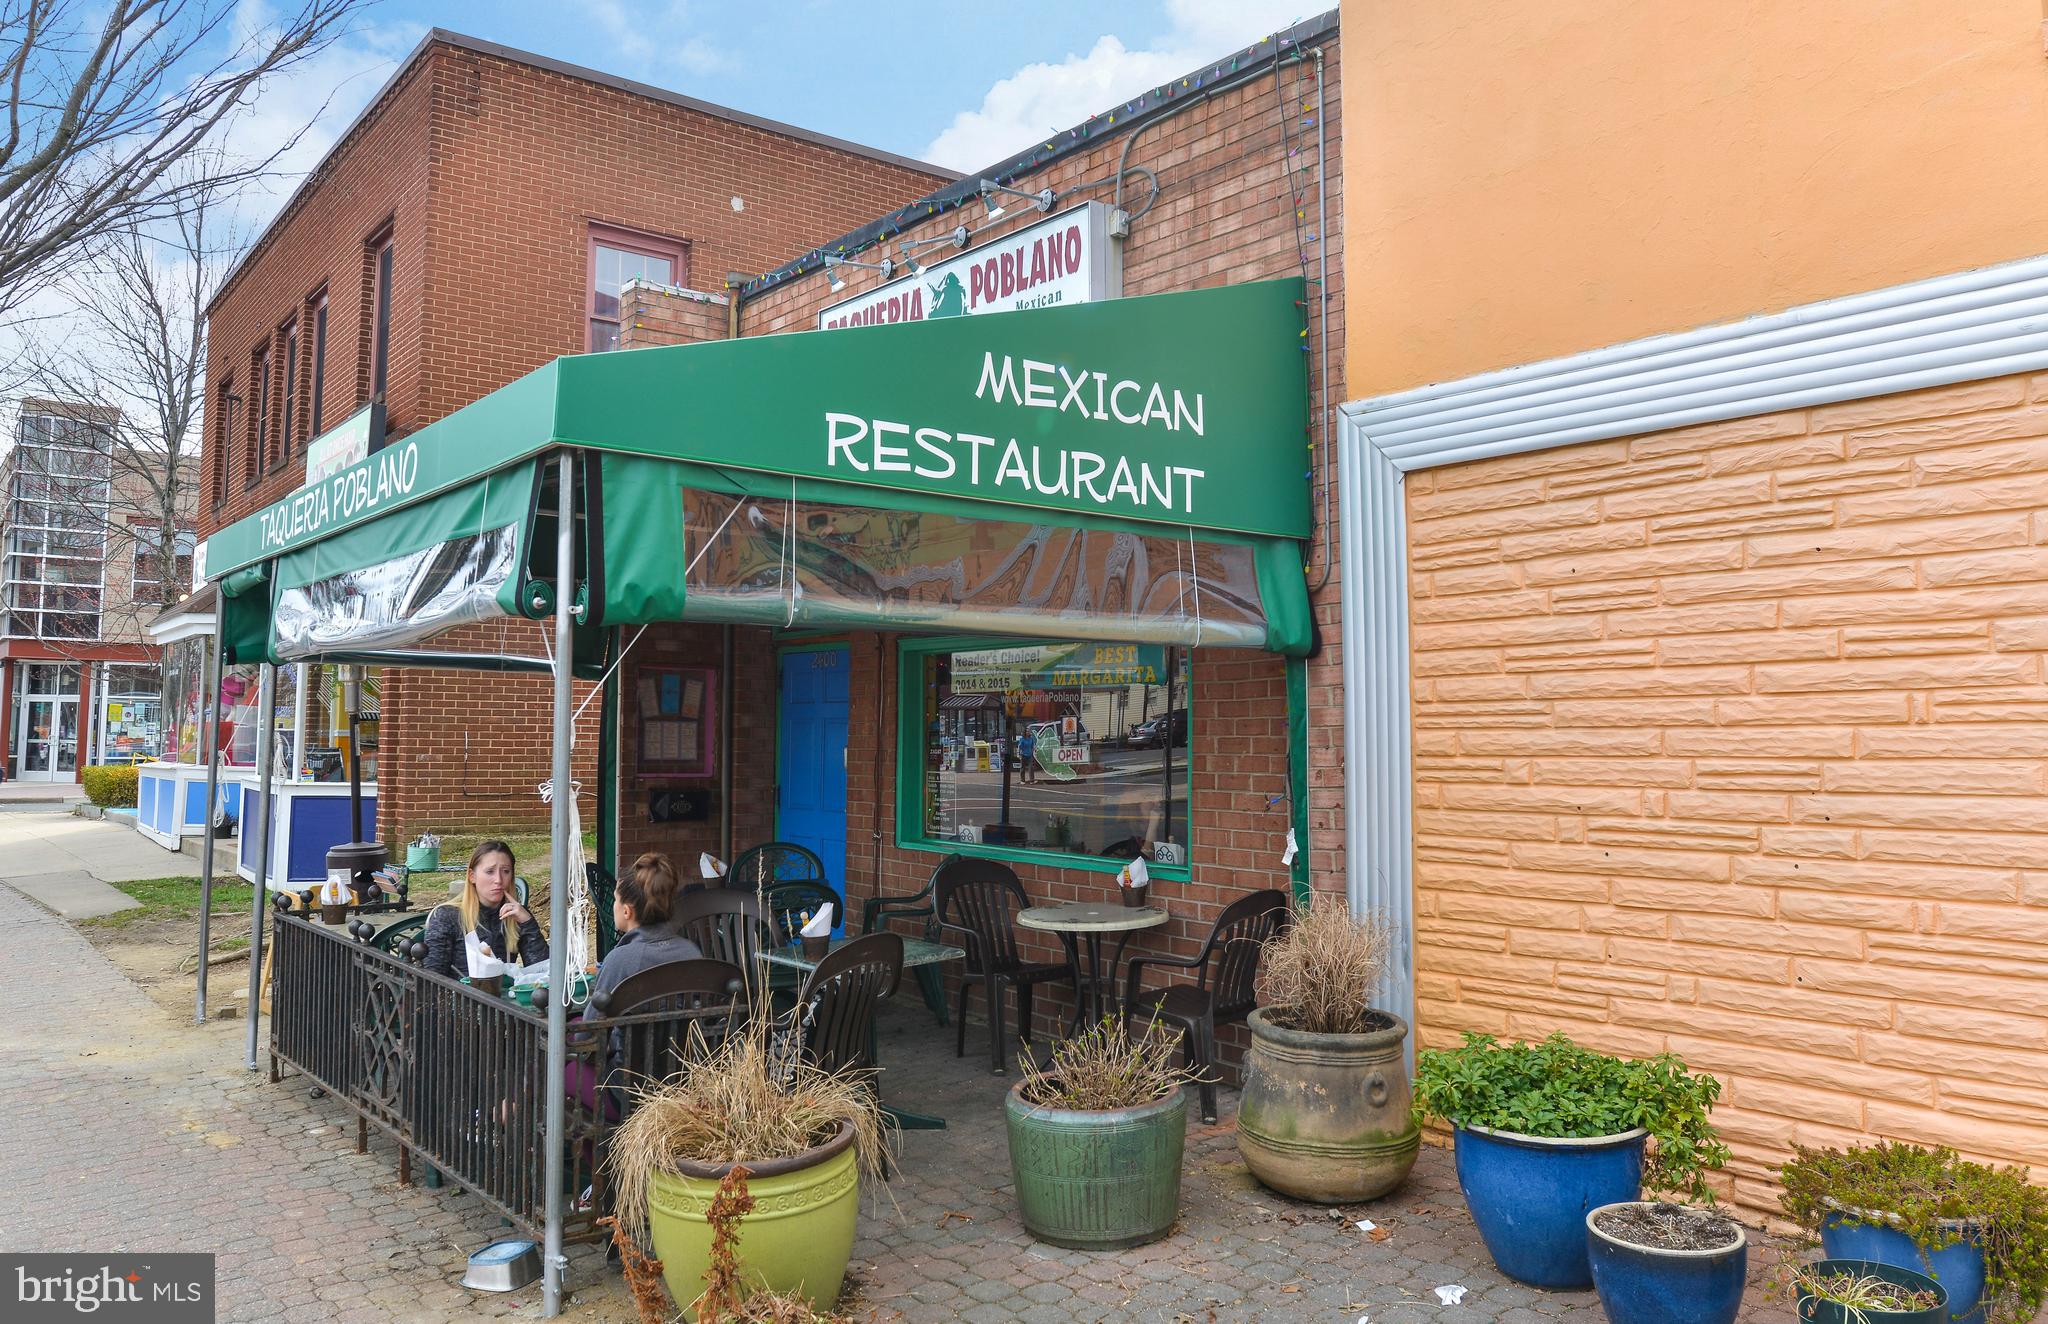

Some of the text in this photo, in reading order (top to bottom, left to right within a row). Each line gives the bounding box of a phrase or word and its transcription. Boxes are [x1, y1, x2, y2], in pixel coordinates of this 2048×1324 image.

[828, 224, 1081, 329] ERIA POBLANO
[1015, 290, 1062, 310] Mexican
[975, 351, 1204, 436] MEXICAN
[825, 412, 1205, 513] RESTAURANT
[260, 483, 329, 549] TAQUERIA
[333, 442, 417, 520] POBLANO
[955, 649, 1040, 667] Reader's Choice!
[1095, 646, 1136, 664] BEST
[955, 677, 1010, 690] 2014 & 2015
[1053, 666, 1157, 686] MARGARITA
[1058, 749, 1083, 762] OPEN
